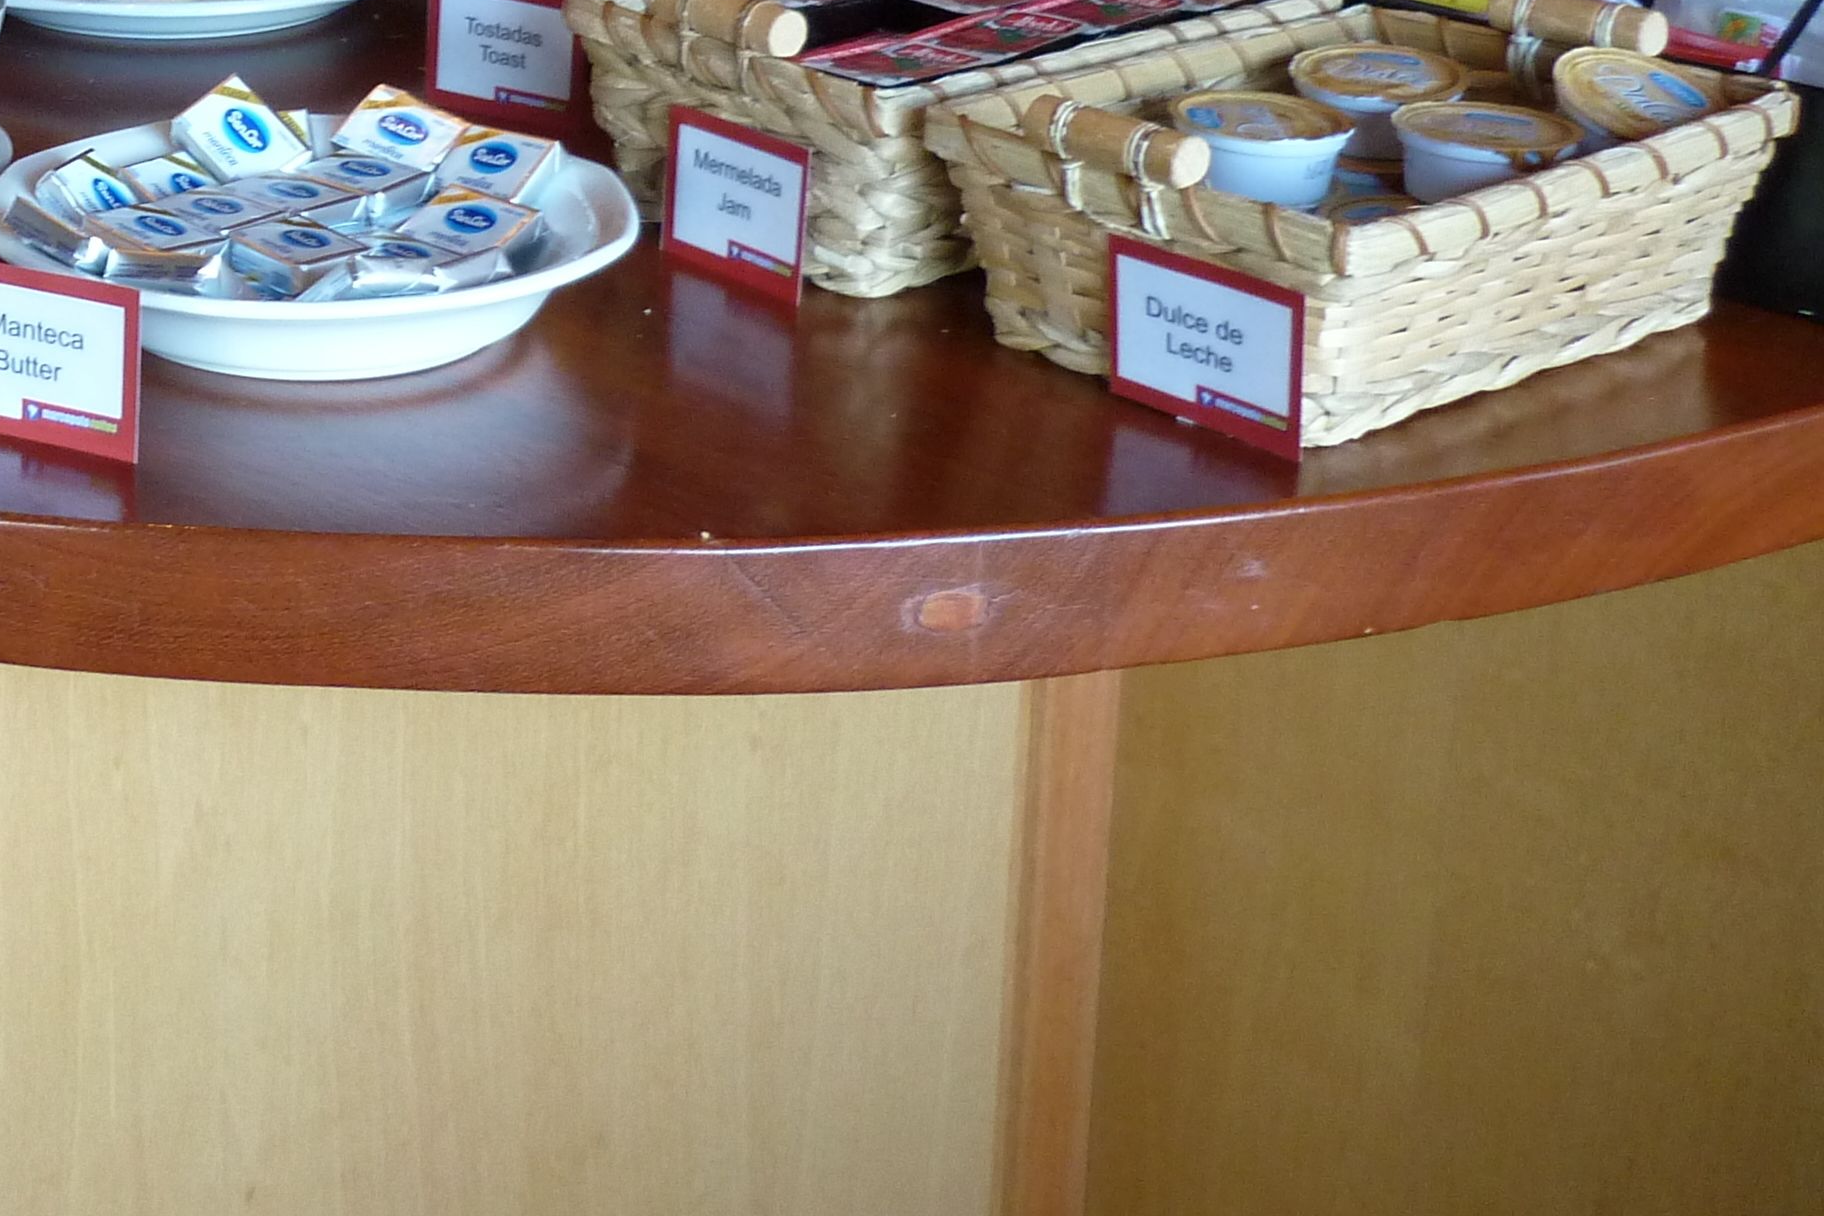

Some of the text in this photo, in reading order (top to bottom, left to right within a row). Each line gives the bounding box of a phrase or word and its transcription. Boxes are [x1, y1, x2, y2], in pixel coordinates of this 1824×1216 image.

[464, 15, 544, 48] Tostadas
[478, 44, 527, 70] Toast
[692, 148, 783, 198] Mermelada
[717, 192, 753, 221] Jam
[1145, 295, 1245, 346] Dulce de
[1165, 333, 1234, 374] Leche
